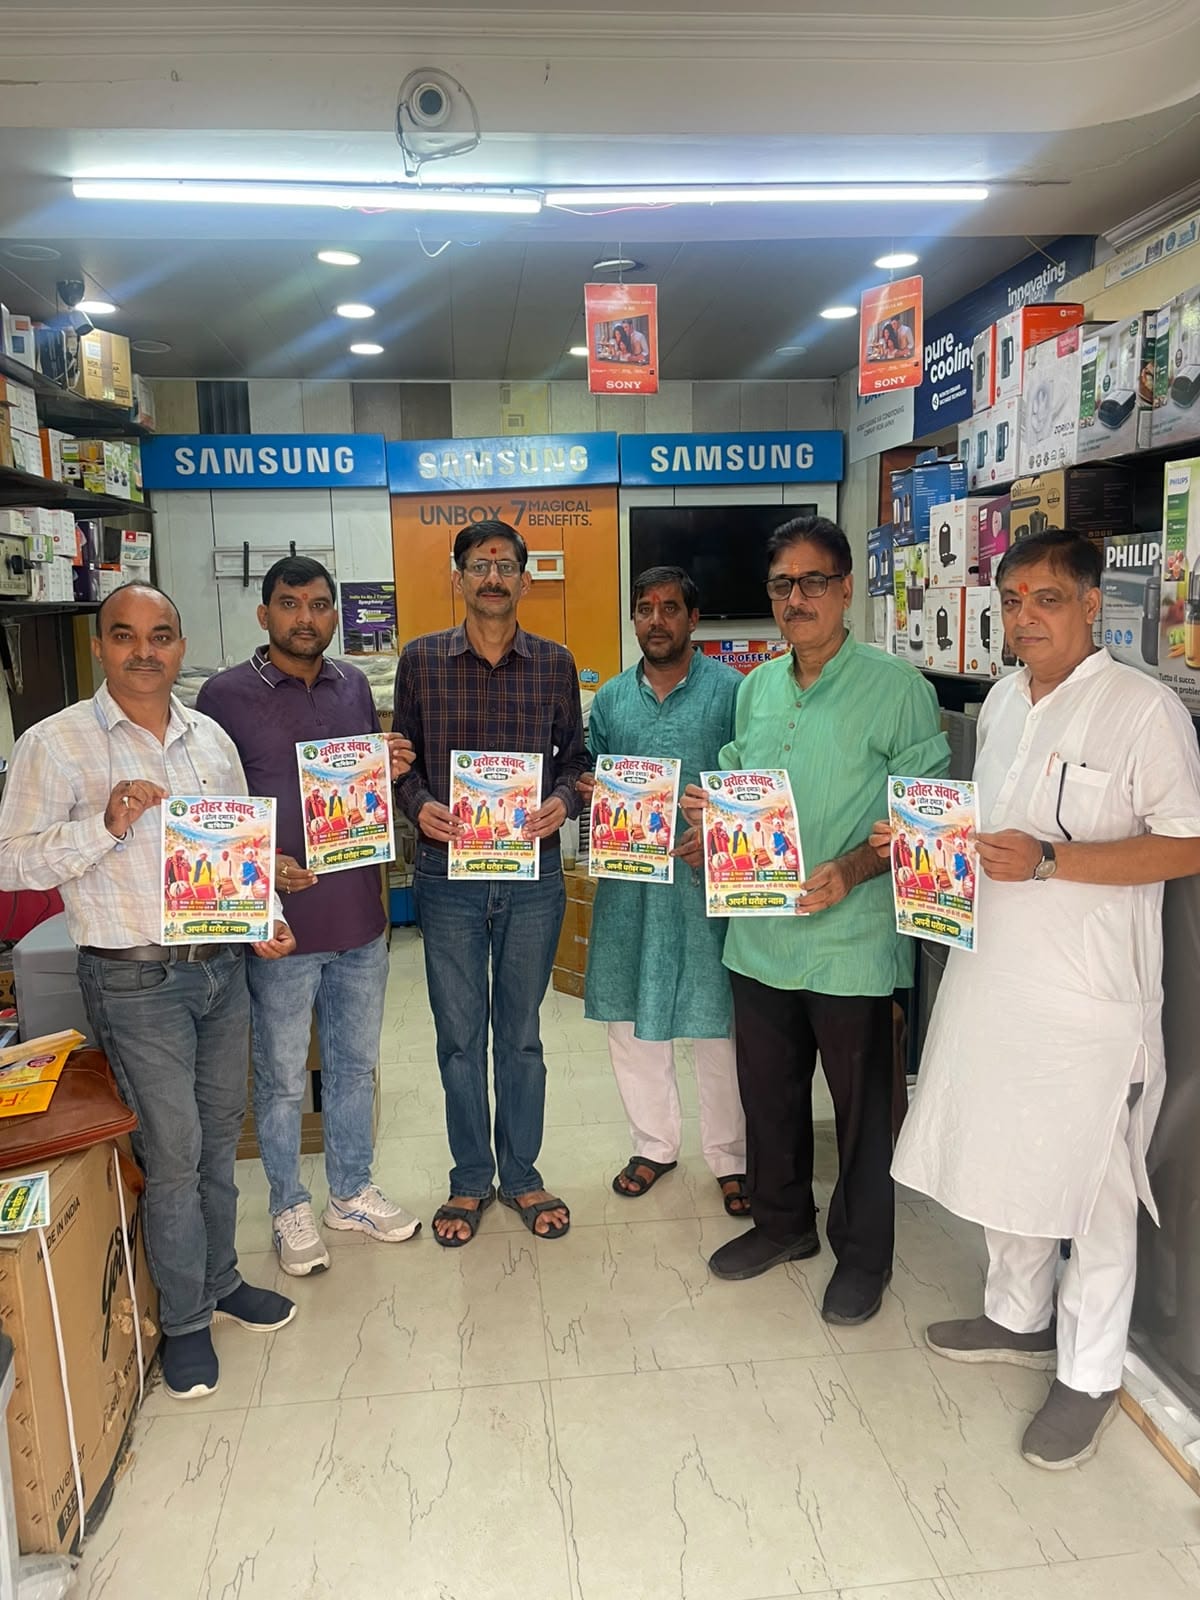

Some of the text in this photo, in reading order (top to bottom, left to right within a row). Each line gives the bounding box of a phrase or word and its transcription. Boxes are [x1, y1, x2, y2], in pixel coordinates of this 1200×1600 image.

[1008, 260, 1066, 306] innovating
[925, 333, 954, 371] pure
[606, 381, 642, 389] SONY
[874, 376, 906, 388] SONY
[175, 446, 355, 475] SAMSUNG
[418, 445, 589, 480] SAMSUNG
[651, 443, 814, 472] SAMSUNG
[419, 500, 526, 526] UNBOX 7
[528, 500, 593, 512] MAGICAL
[528, 514, 593, 526] BENEFITS.
[1105, 542, 1163, 569] PHILIP
[736, 651, 772, 662] OFFER
[320, 739, 372, 756] धरोहर संवाद
[473, 754, 526, 771] धरोहर संवाद
[615, 757, 664, 776] धरोहर संवाद
[724, 772, 776, 790] धरोहर संवाद
[907, 781, 961, 805] धरोहर संवाद
[190, 799, 256, 818] धरोहर संवाद
[37, 1195, 81, 1264] MDE IN INDIA
[51, 1443, 85, 1510] Inverer
